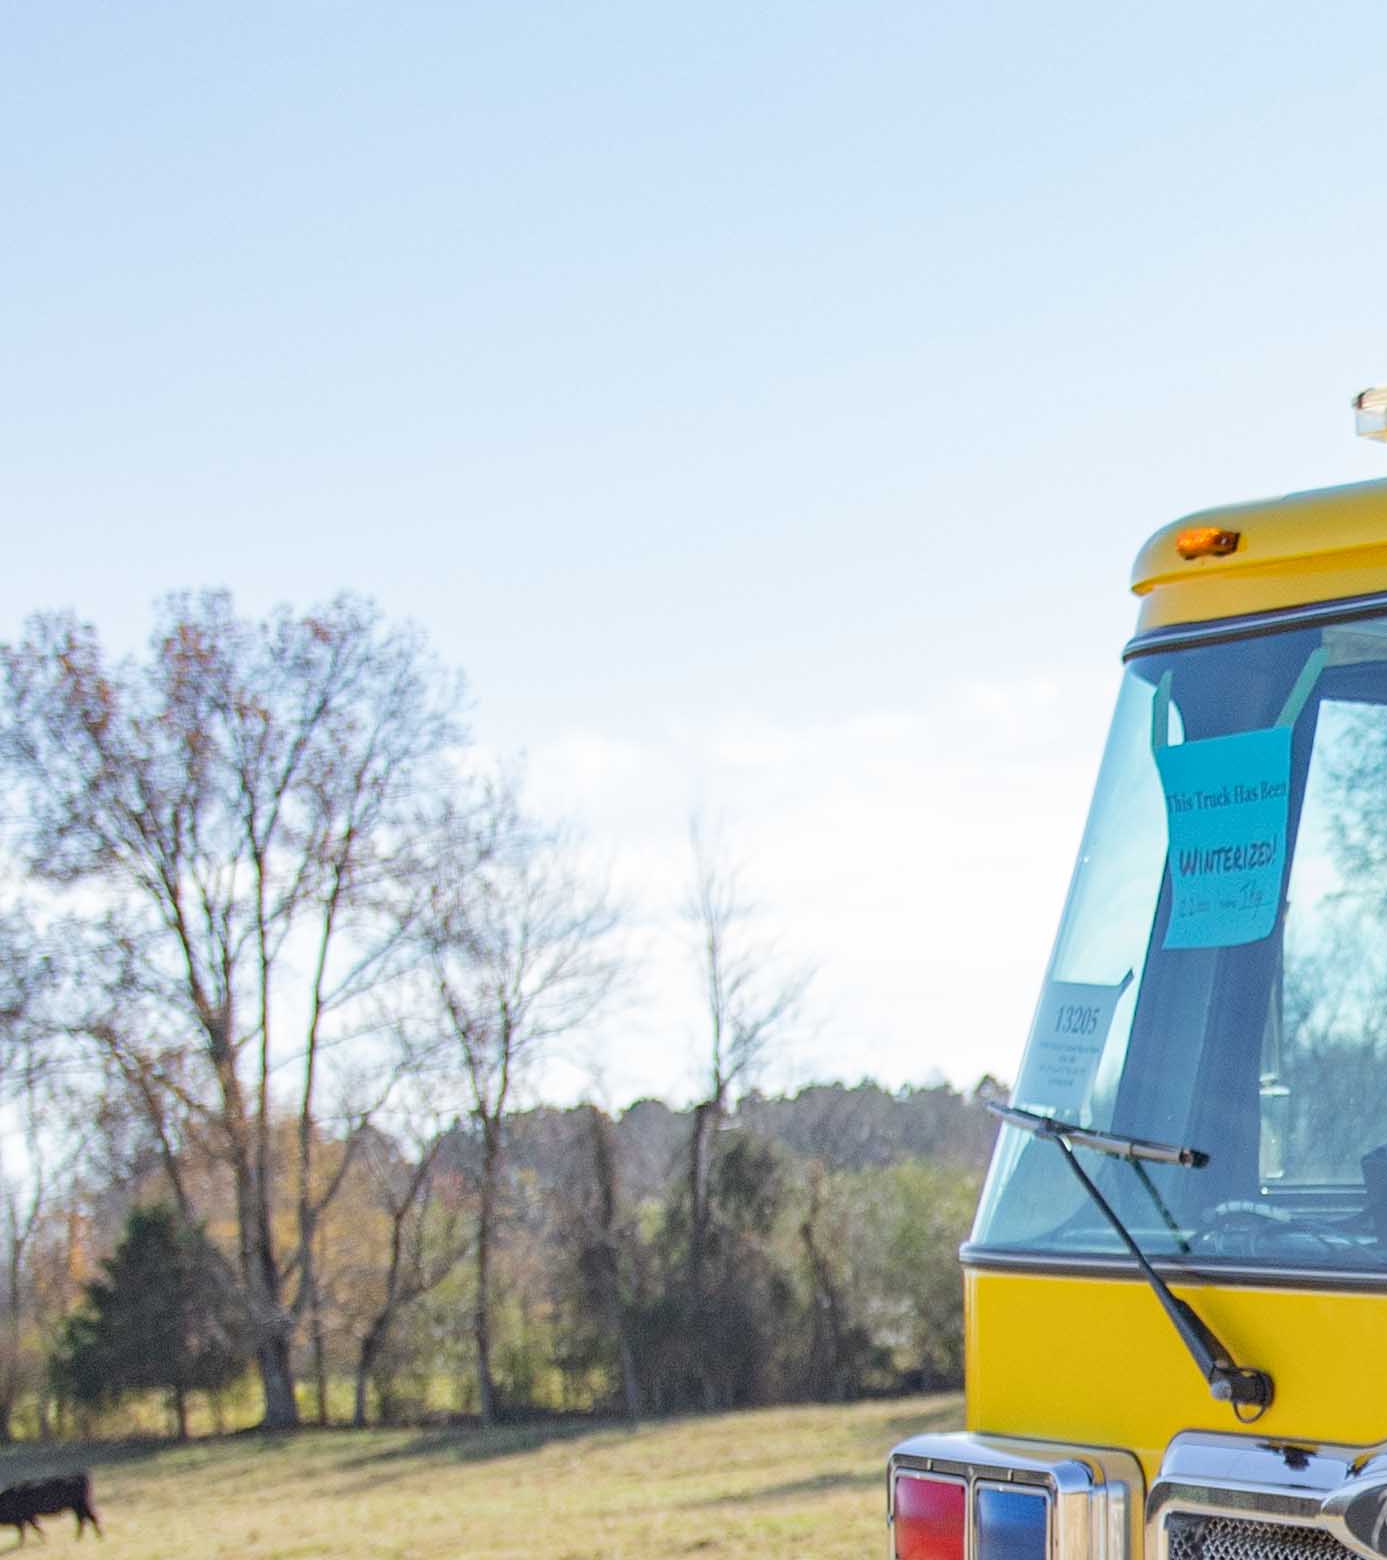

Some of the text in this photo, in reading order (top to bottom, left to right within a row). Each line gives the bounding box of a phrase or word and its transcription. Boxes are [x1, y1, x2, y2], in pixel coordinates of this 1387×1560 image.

[1167, 781, 1288, 813] This Truck Has Been
[1179, 835, 1277, 876] WINTERIZED!
[1055, 1004, 1101, 1035] 13205
